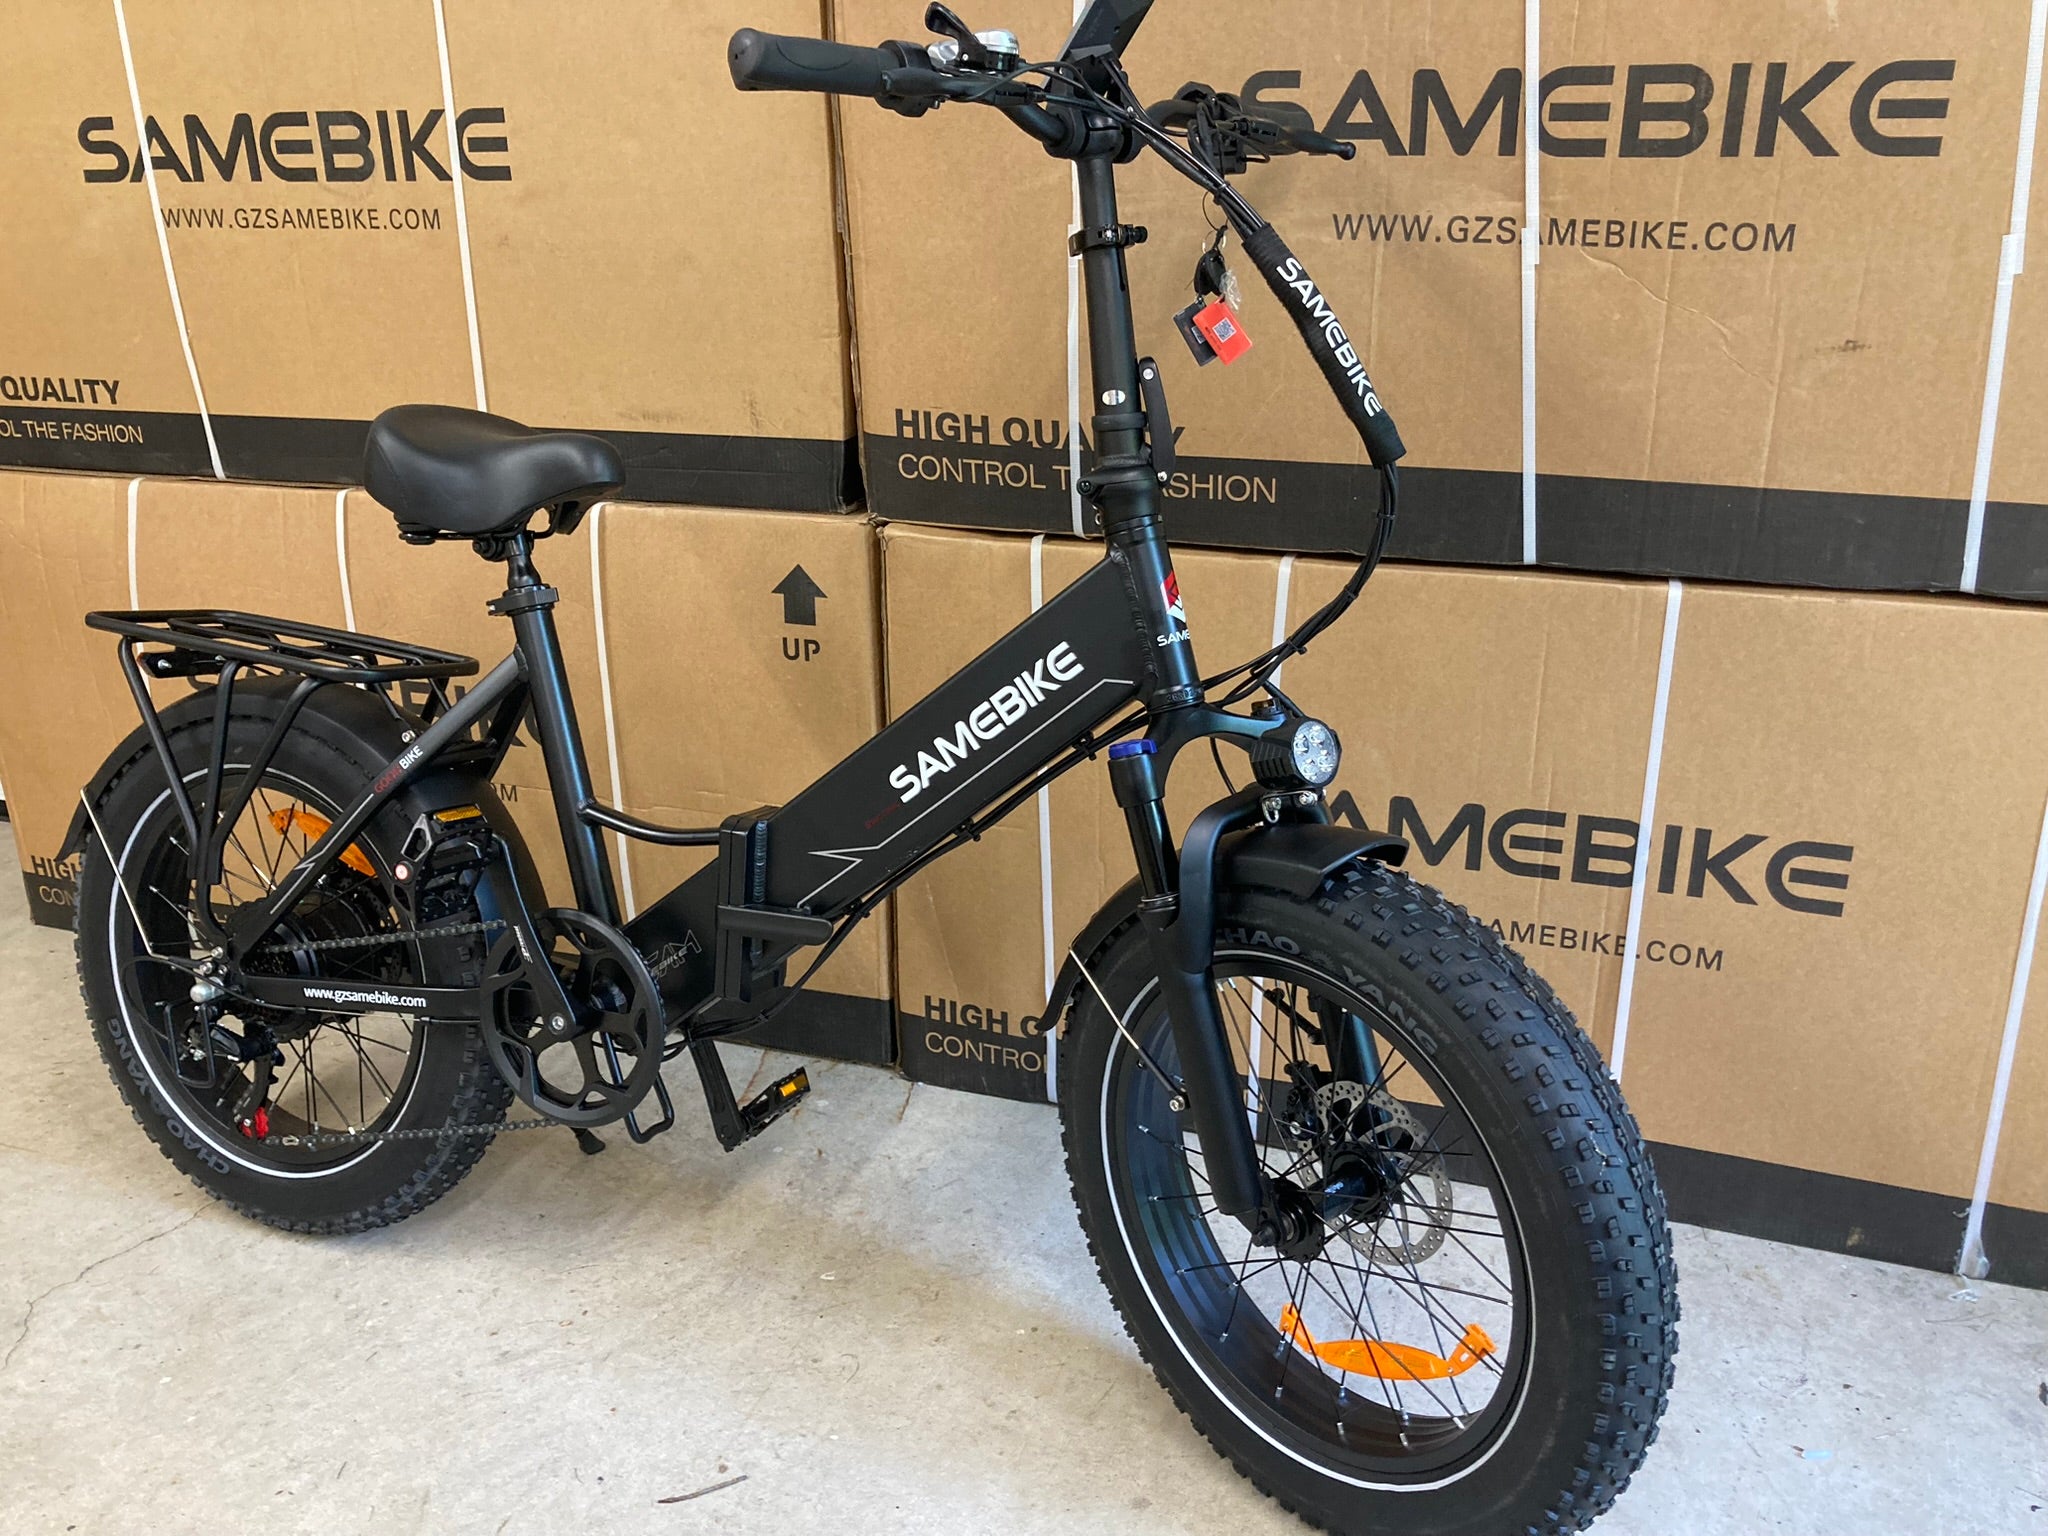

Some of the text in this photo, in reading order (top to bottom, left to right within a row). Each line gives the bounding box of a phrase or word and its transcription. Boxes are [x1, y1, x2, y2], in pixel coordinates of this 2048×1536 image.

[77, 107, 512, 183] SAMEBIKE
[160, 207, 441, 231] WWW.GZSAMEBIKE.COM
[1332, 212, 1797, 253] WWW.GZSMEBIKE.COM
[1276, 257, 1383, 418] SAMEBIKE
[0, 375, 120, 405] QUALITY
[22, 420, 60, 440] THE
[61, 422, 144, 444] FASHION
[894, 408, 990, 446] HIGH
[898, 452, 1047, 490] CONTROL
[1161, 471, 1277, 504] SHION
[782, 636, 821, 662] UP
[889, 640, 1085, 804] SAMEBIKE
[1329, 789, 1855, 919] AMEBIKE
[303, 987, 427, 1008] www.gzsamebike.com
[924, 994, 1009, 1037] HIGH
